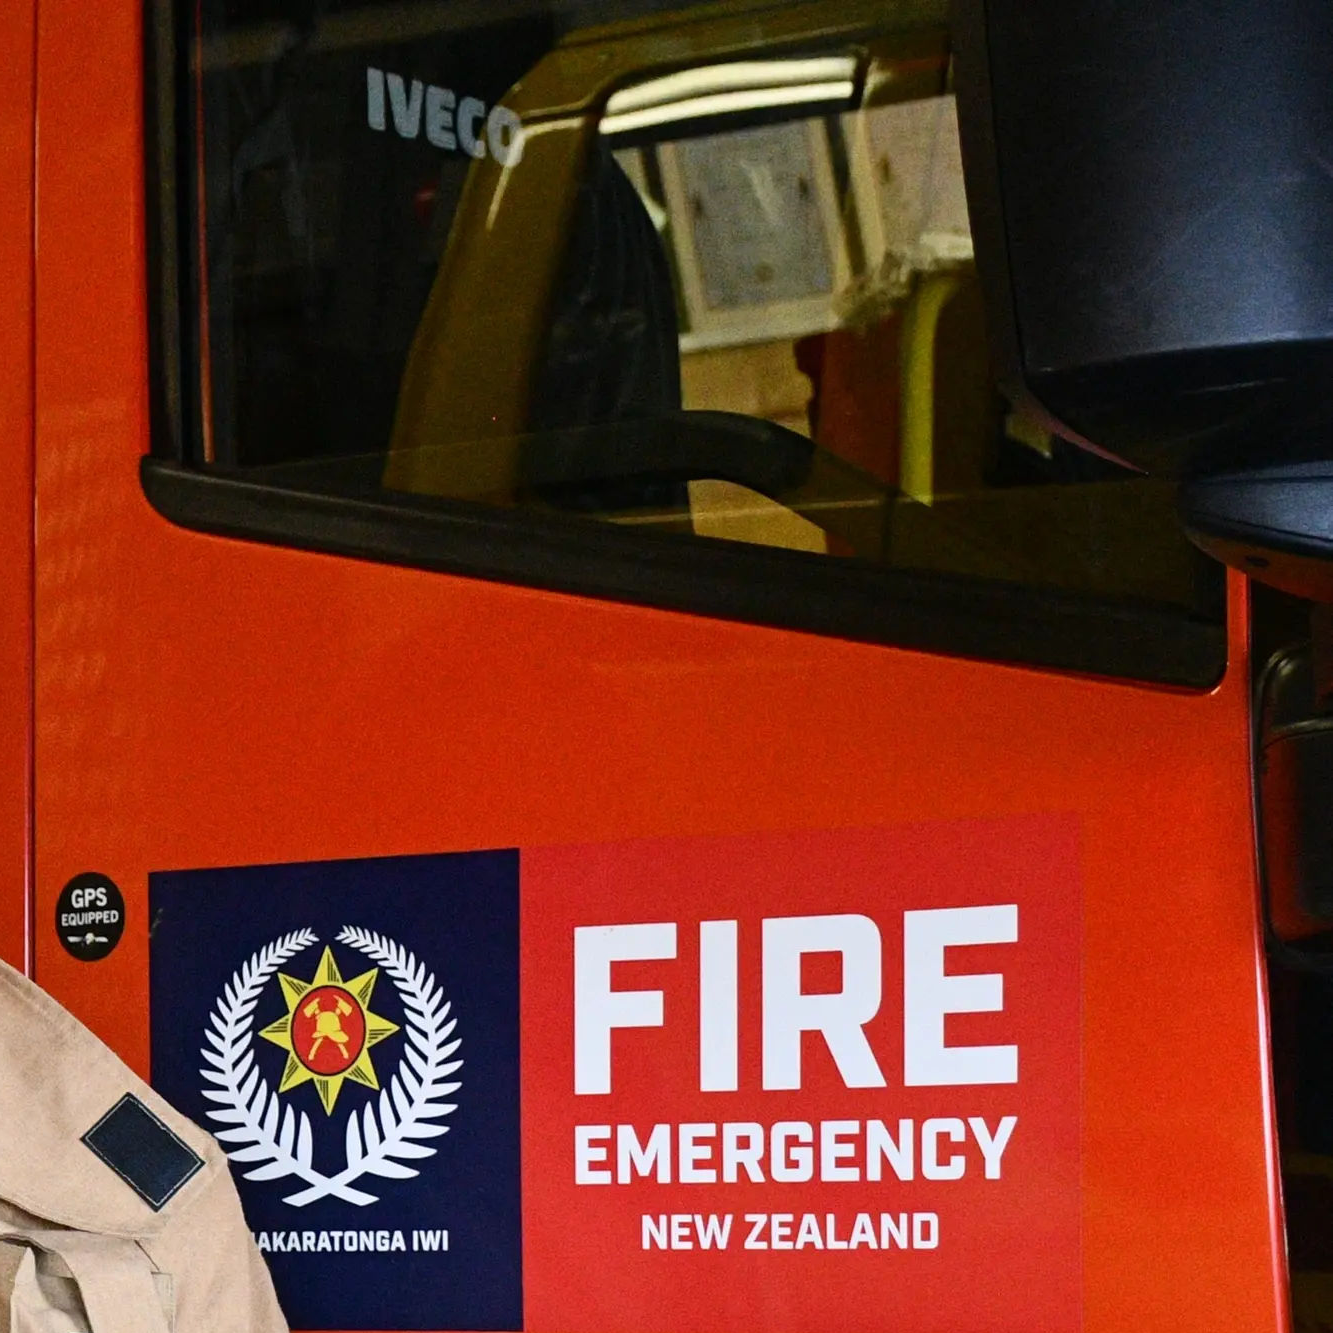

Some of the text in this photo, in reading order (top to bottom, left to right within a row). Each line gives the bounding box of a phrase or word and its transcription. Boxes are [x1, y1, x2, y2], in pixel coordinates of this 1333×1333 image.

[367, 66, 526, 168] IVECO
[71, 887, 107, 908] GPS
[61, 910, 119, 927] EQUIPPED
[573, 903, 1019, 1096] FIRE
[574, 1116, 1019, 1186] EMERGENCY
[251, 1229, 449, 1252] AKARATONGA IWI
[641, 1211, 940, 1252] NEW ZEALAND
